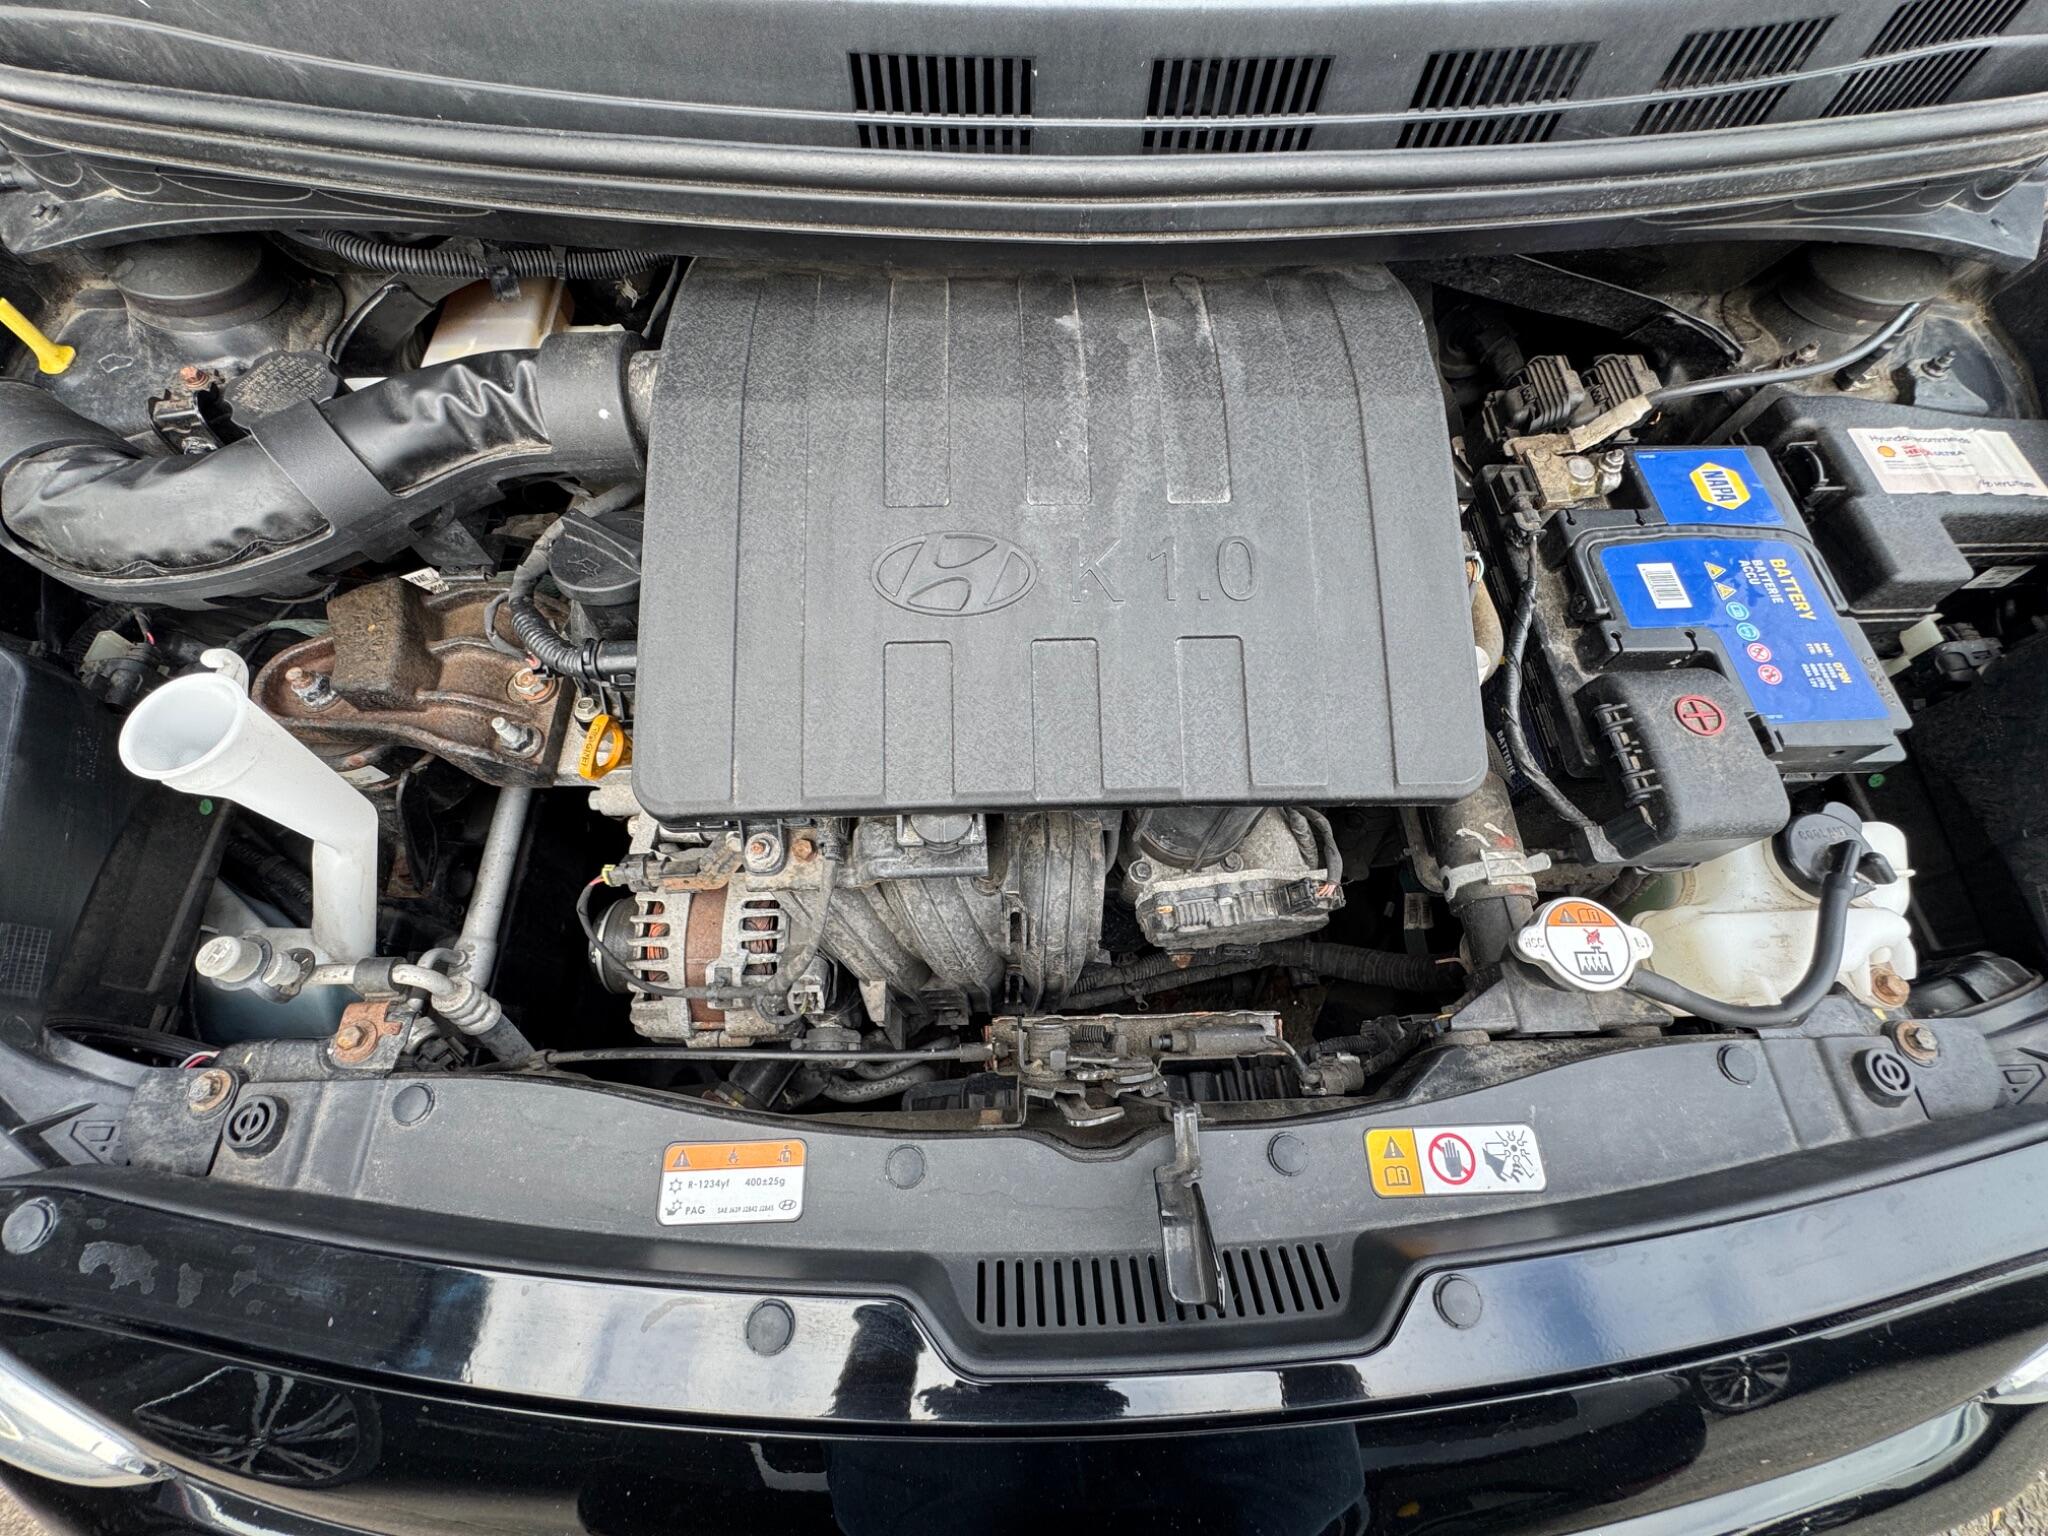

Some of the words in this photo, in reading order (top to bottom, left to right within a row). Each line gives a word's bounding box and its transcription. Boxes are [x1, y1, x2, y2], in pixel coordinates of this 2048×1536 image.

[1702, 470, 1738, 502] NAPA
[1069, 536, 1125, 603] K
[1146, 535, 1260, 602] 1.0
[1738, 559, 1762, 585] ACCU
[1751, 559, 1785, 604] BATTERIE
[1769, 558, 1817, 620] BATTERY
[687, 1179, 729, 1189] R-1234yf
[745, 1177, 785, 1187] 400±25g
[685, 1205, 706, 1215] PAG
[717, 1206, 728, 1214] SAE
